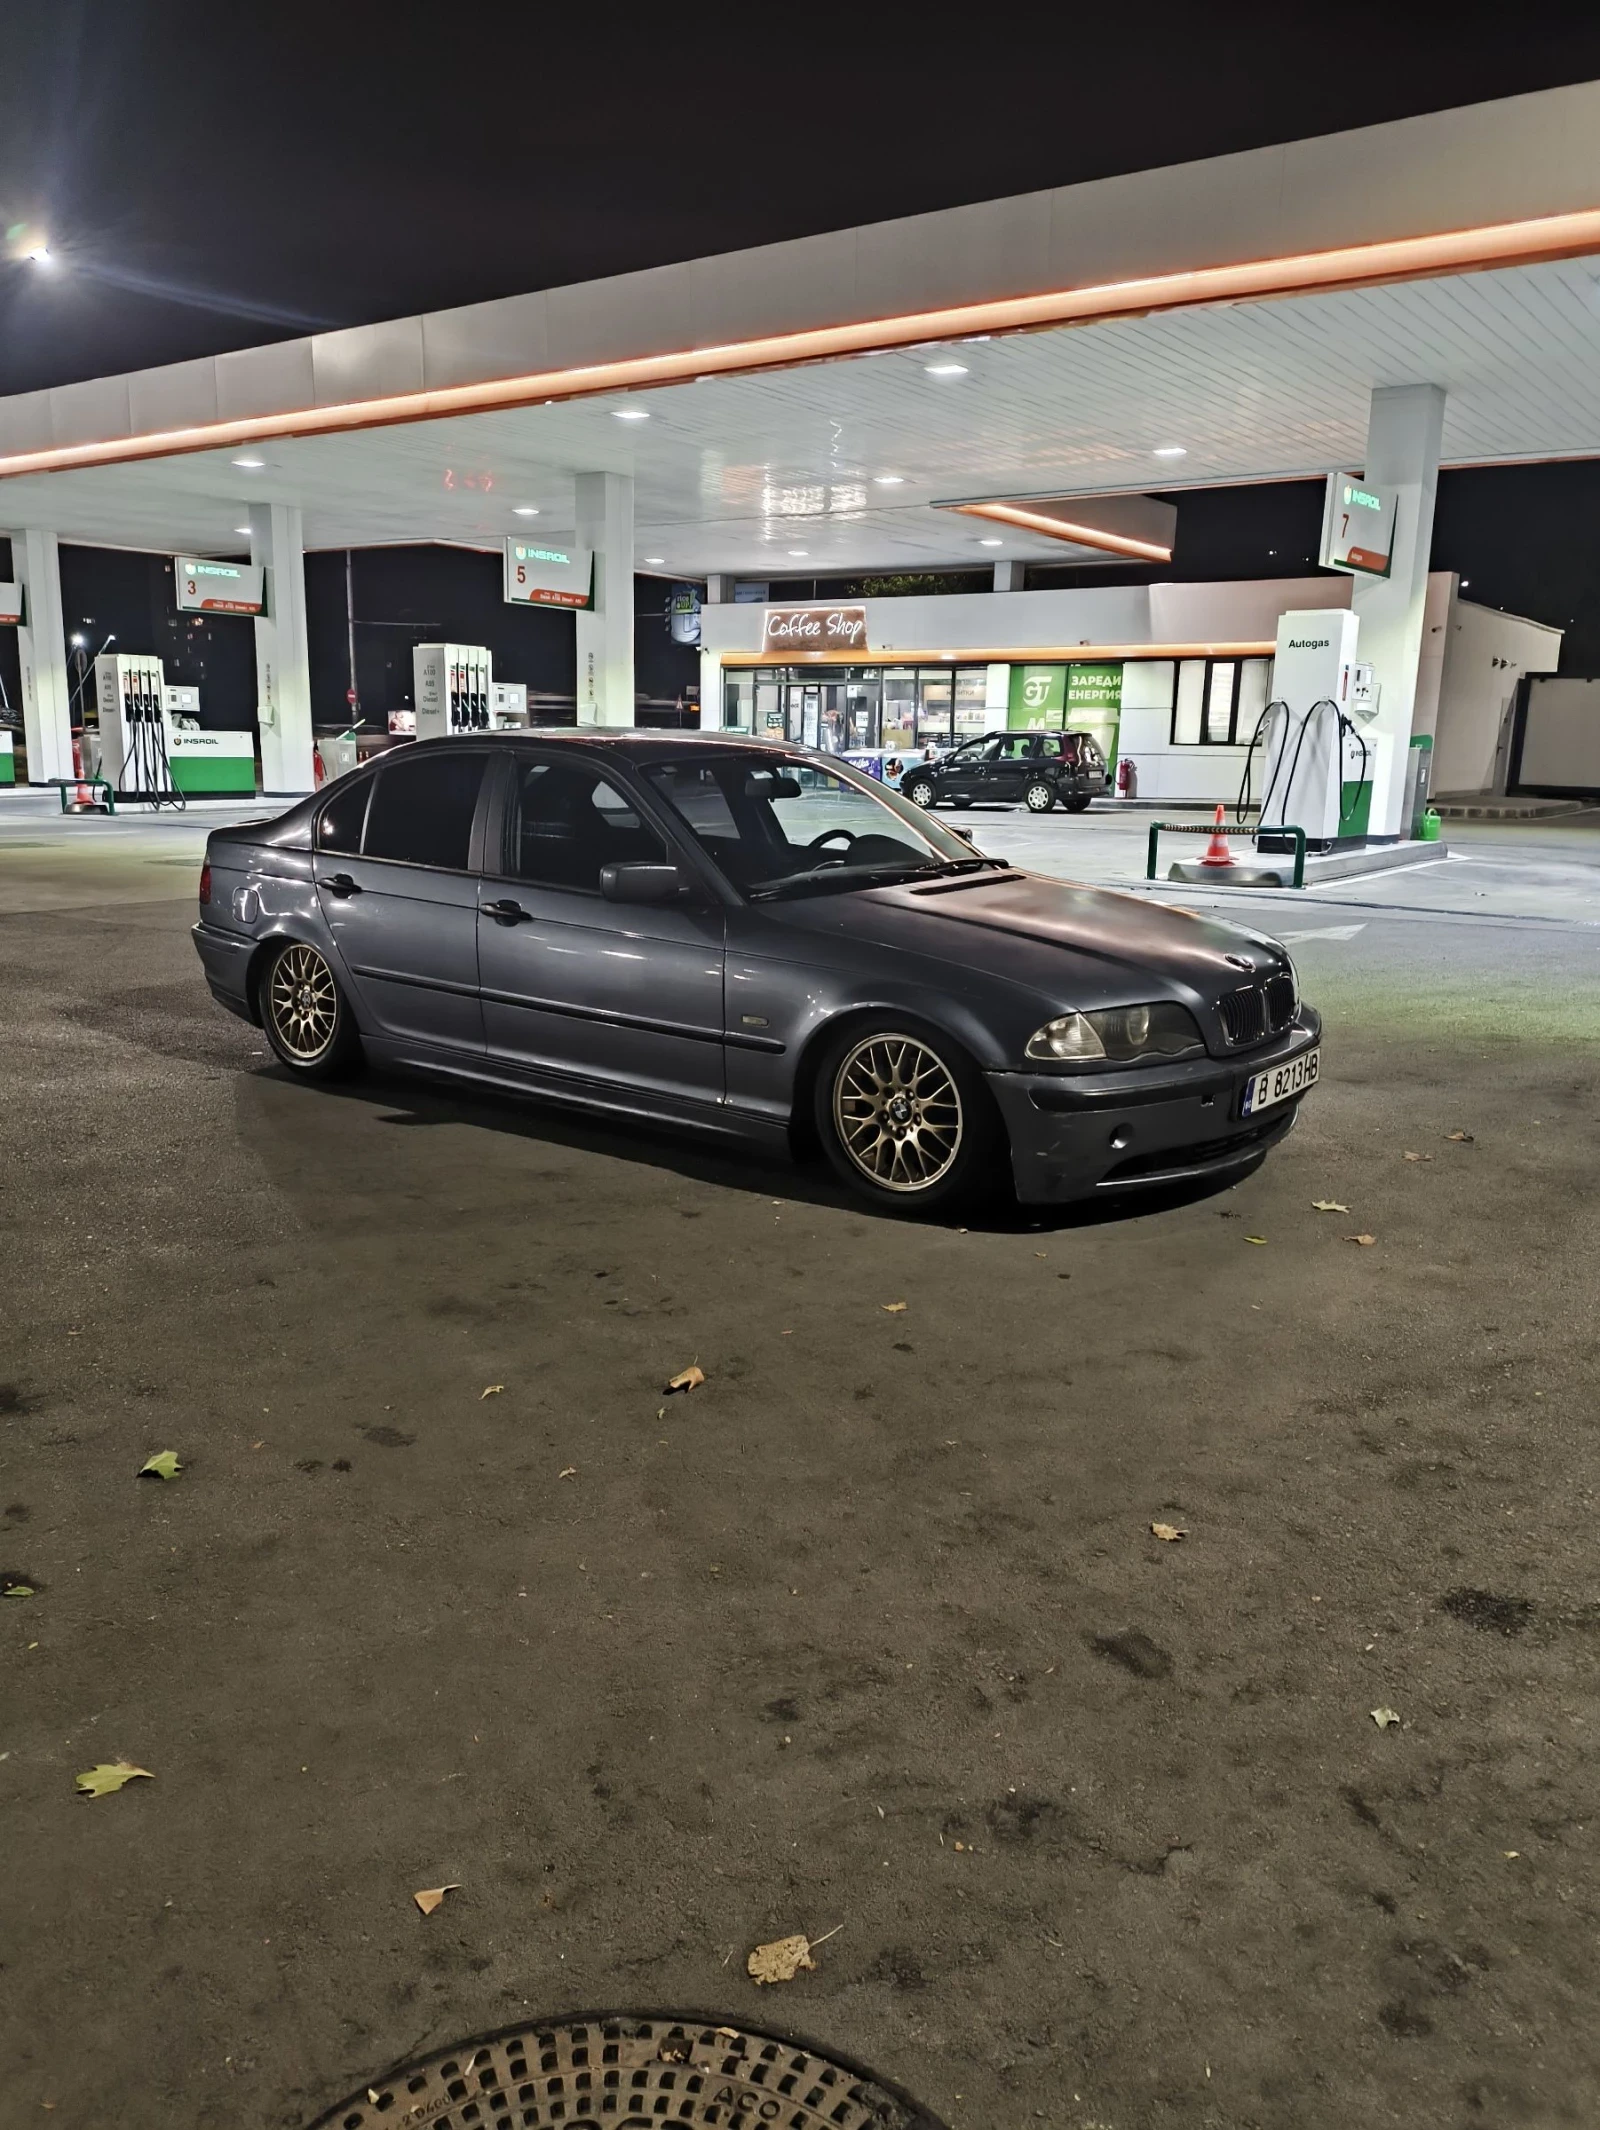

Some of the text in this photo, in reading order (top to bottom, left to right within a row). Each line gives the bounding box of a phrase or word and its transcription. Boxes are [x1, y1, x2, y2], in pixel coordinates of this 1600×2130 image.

[1342, 513, 1349, 538] 7
[517, 565, 526, 584] 5
[187, 580, 196, 595] 3
[768, 612, 864, 644] Coffee Shop
[1288, 639, 1330, 649] Autogas
[1071, 675, 1122, 687] ЗАРЕДИ
[1068, 689, 1122, 700] ЕНЕРГИЯ
[713, 2086, 781, 2120] ACO
